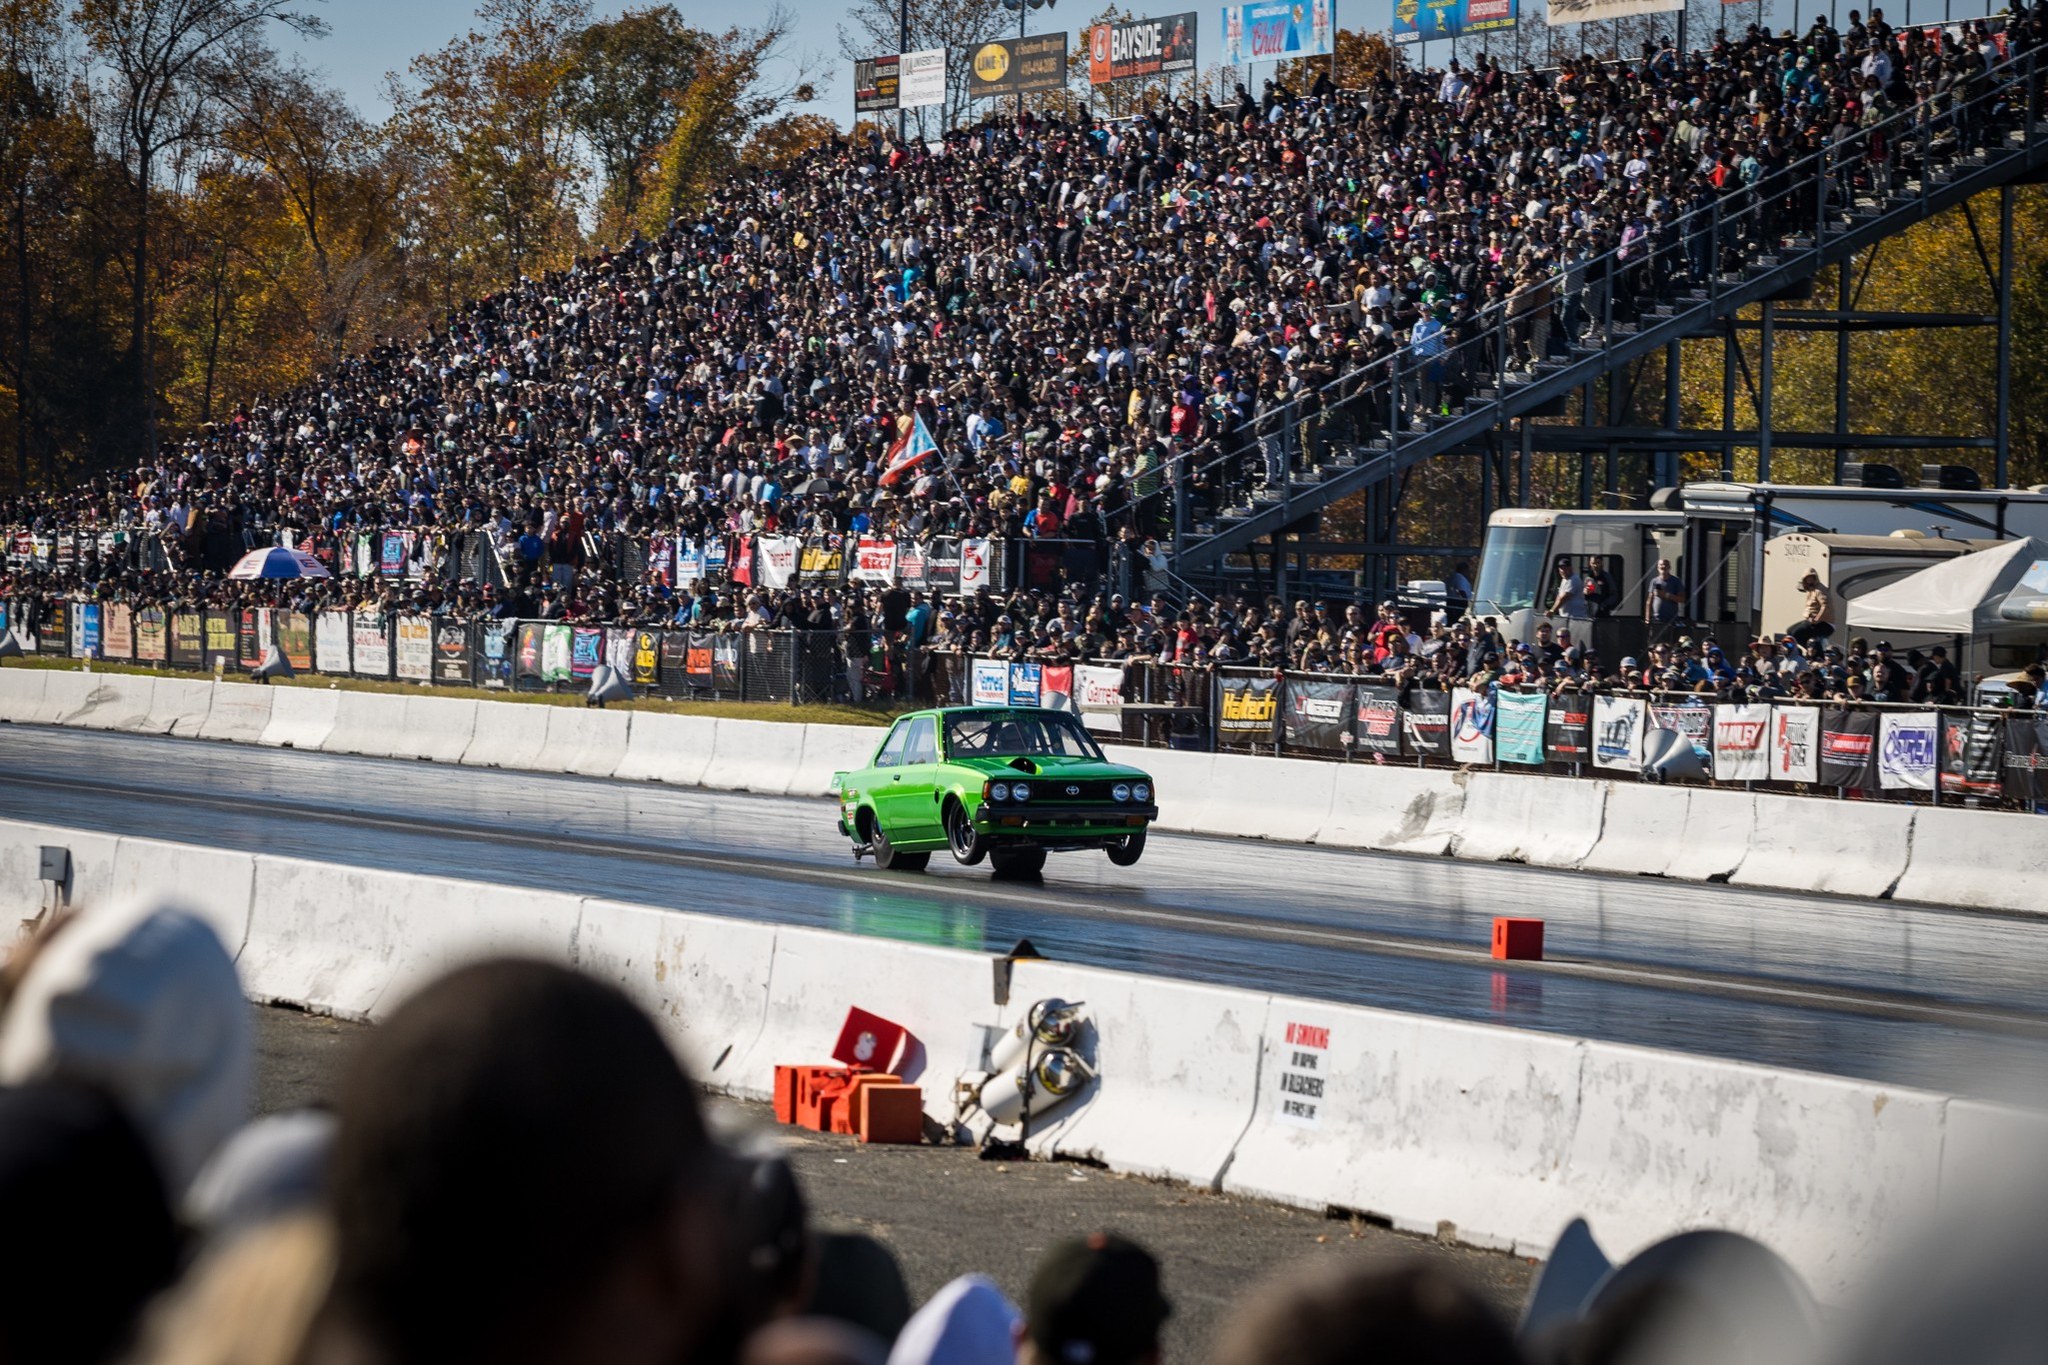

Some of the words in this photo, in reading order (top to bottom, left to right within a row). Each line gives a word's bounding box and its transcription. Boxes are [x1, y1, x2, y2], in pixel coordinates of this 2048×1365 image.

[1111, 22, 1162, 62] BAYSIDE
[1784, 543, 1811, 557] SUNSET
[1222, 687, 1277, 720] Haltech
[1296, 1024, 1330, 1050] SMOKING
